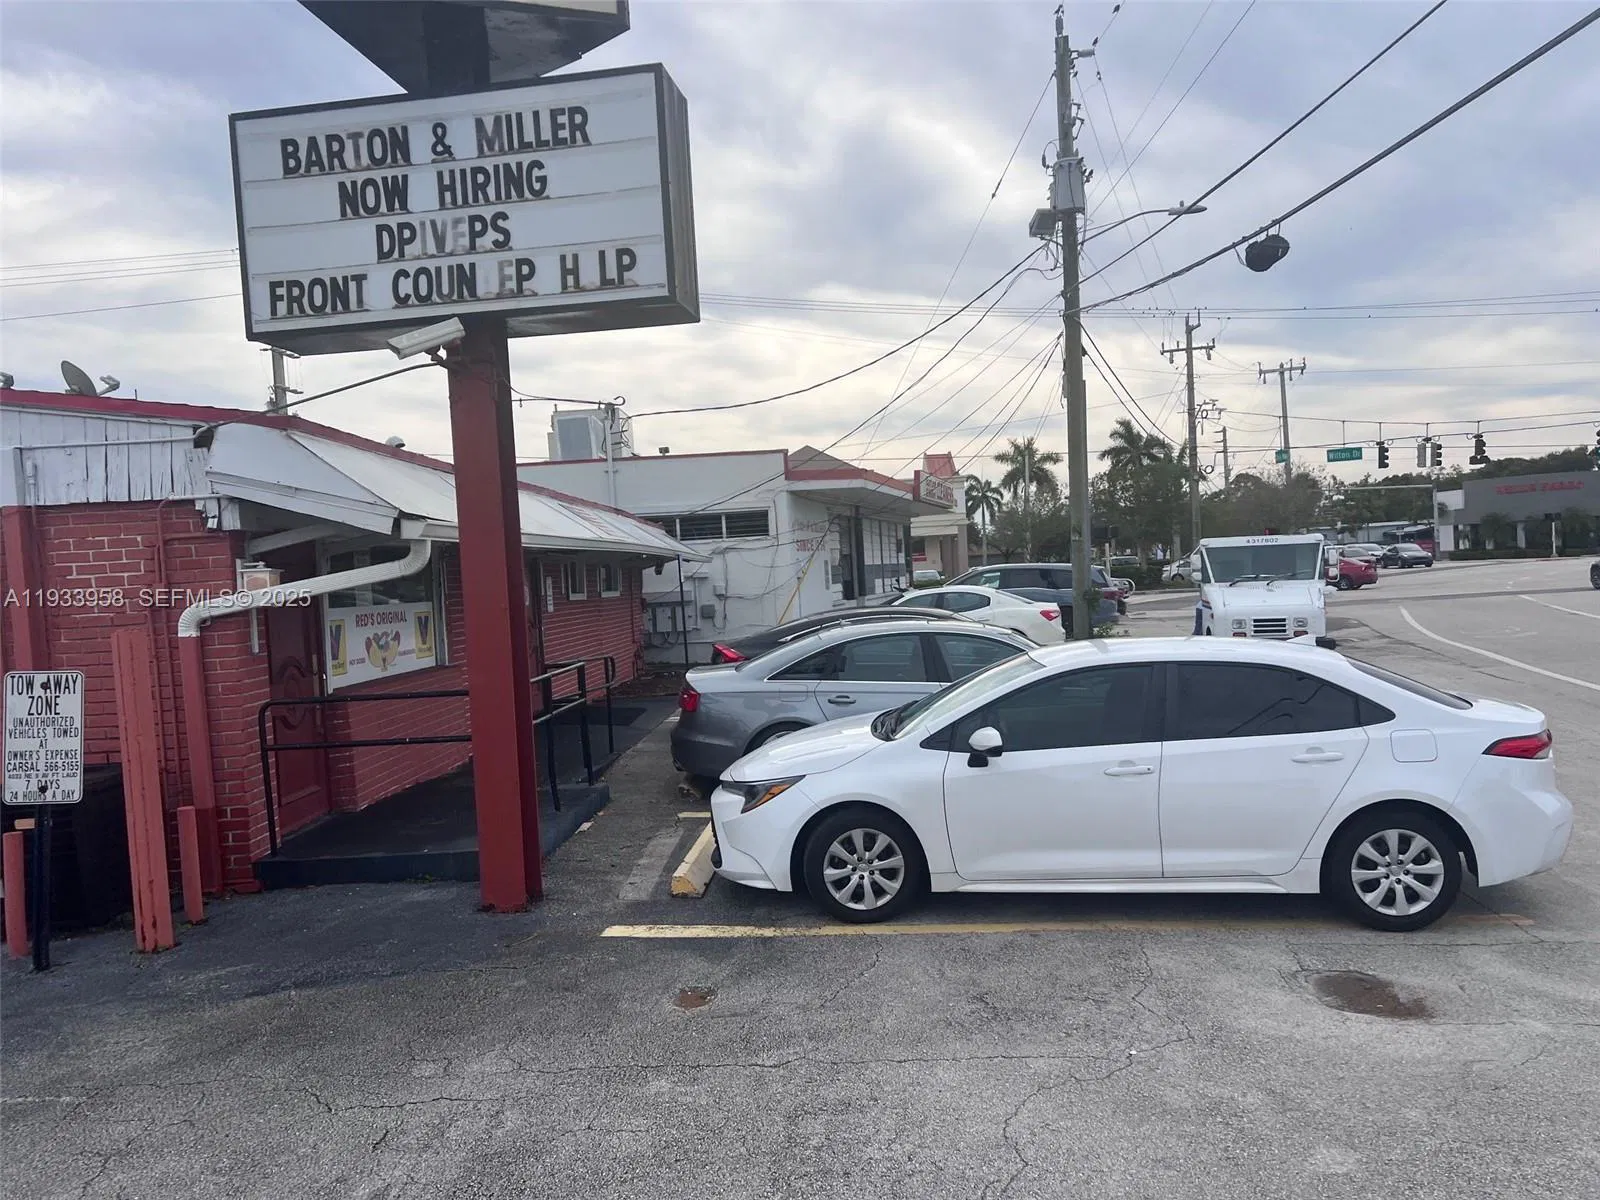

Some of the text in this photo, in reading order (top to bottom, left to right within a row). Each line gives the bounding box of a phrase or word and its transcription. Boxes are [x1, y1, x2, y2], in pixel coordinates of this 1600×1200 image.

[280, 105, 592, 175] BARTON & MILLER
[338, 159, 547, 218] NOW HIRING
[269, 273, 368, 317] FRONT
[355, 609, 407, 628] RED'S ORIGINAL
[10, 674, 78, 695] TOW AWAY
[27, 695, 60, 716] ZONE
[13, 716, 75, 728] UNAUTHORIZED
[8, 727, 79, 739] VEHICLES TOWED
[39, 739, 48, 749] AT
[45, 749, 78, 760] EXPENSE
[6, 761, 79, 773] CARSAL 566-5155
[25, 779, 60, 791] 7 DAYS
[10, 789, 76, 802] 24 HOURS A DAY
